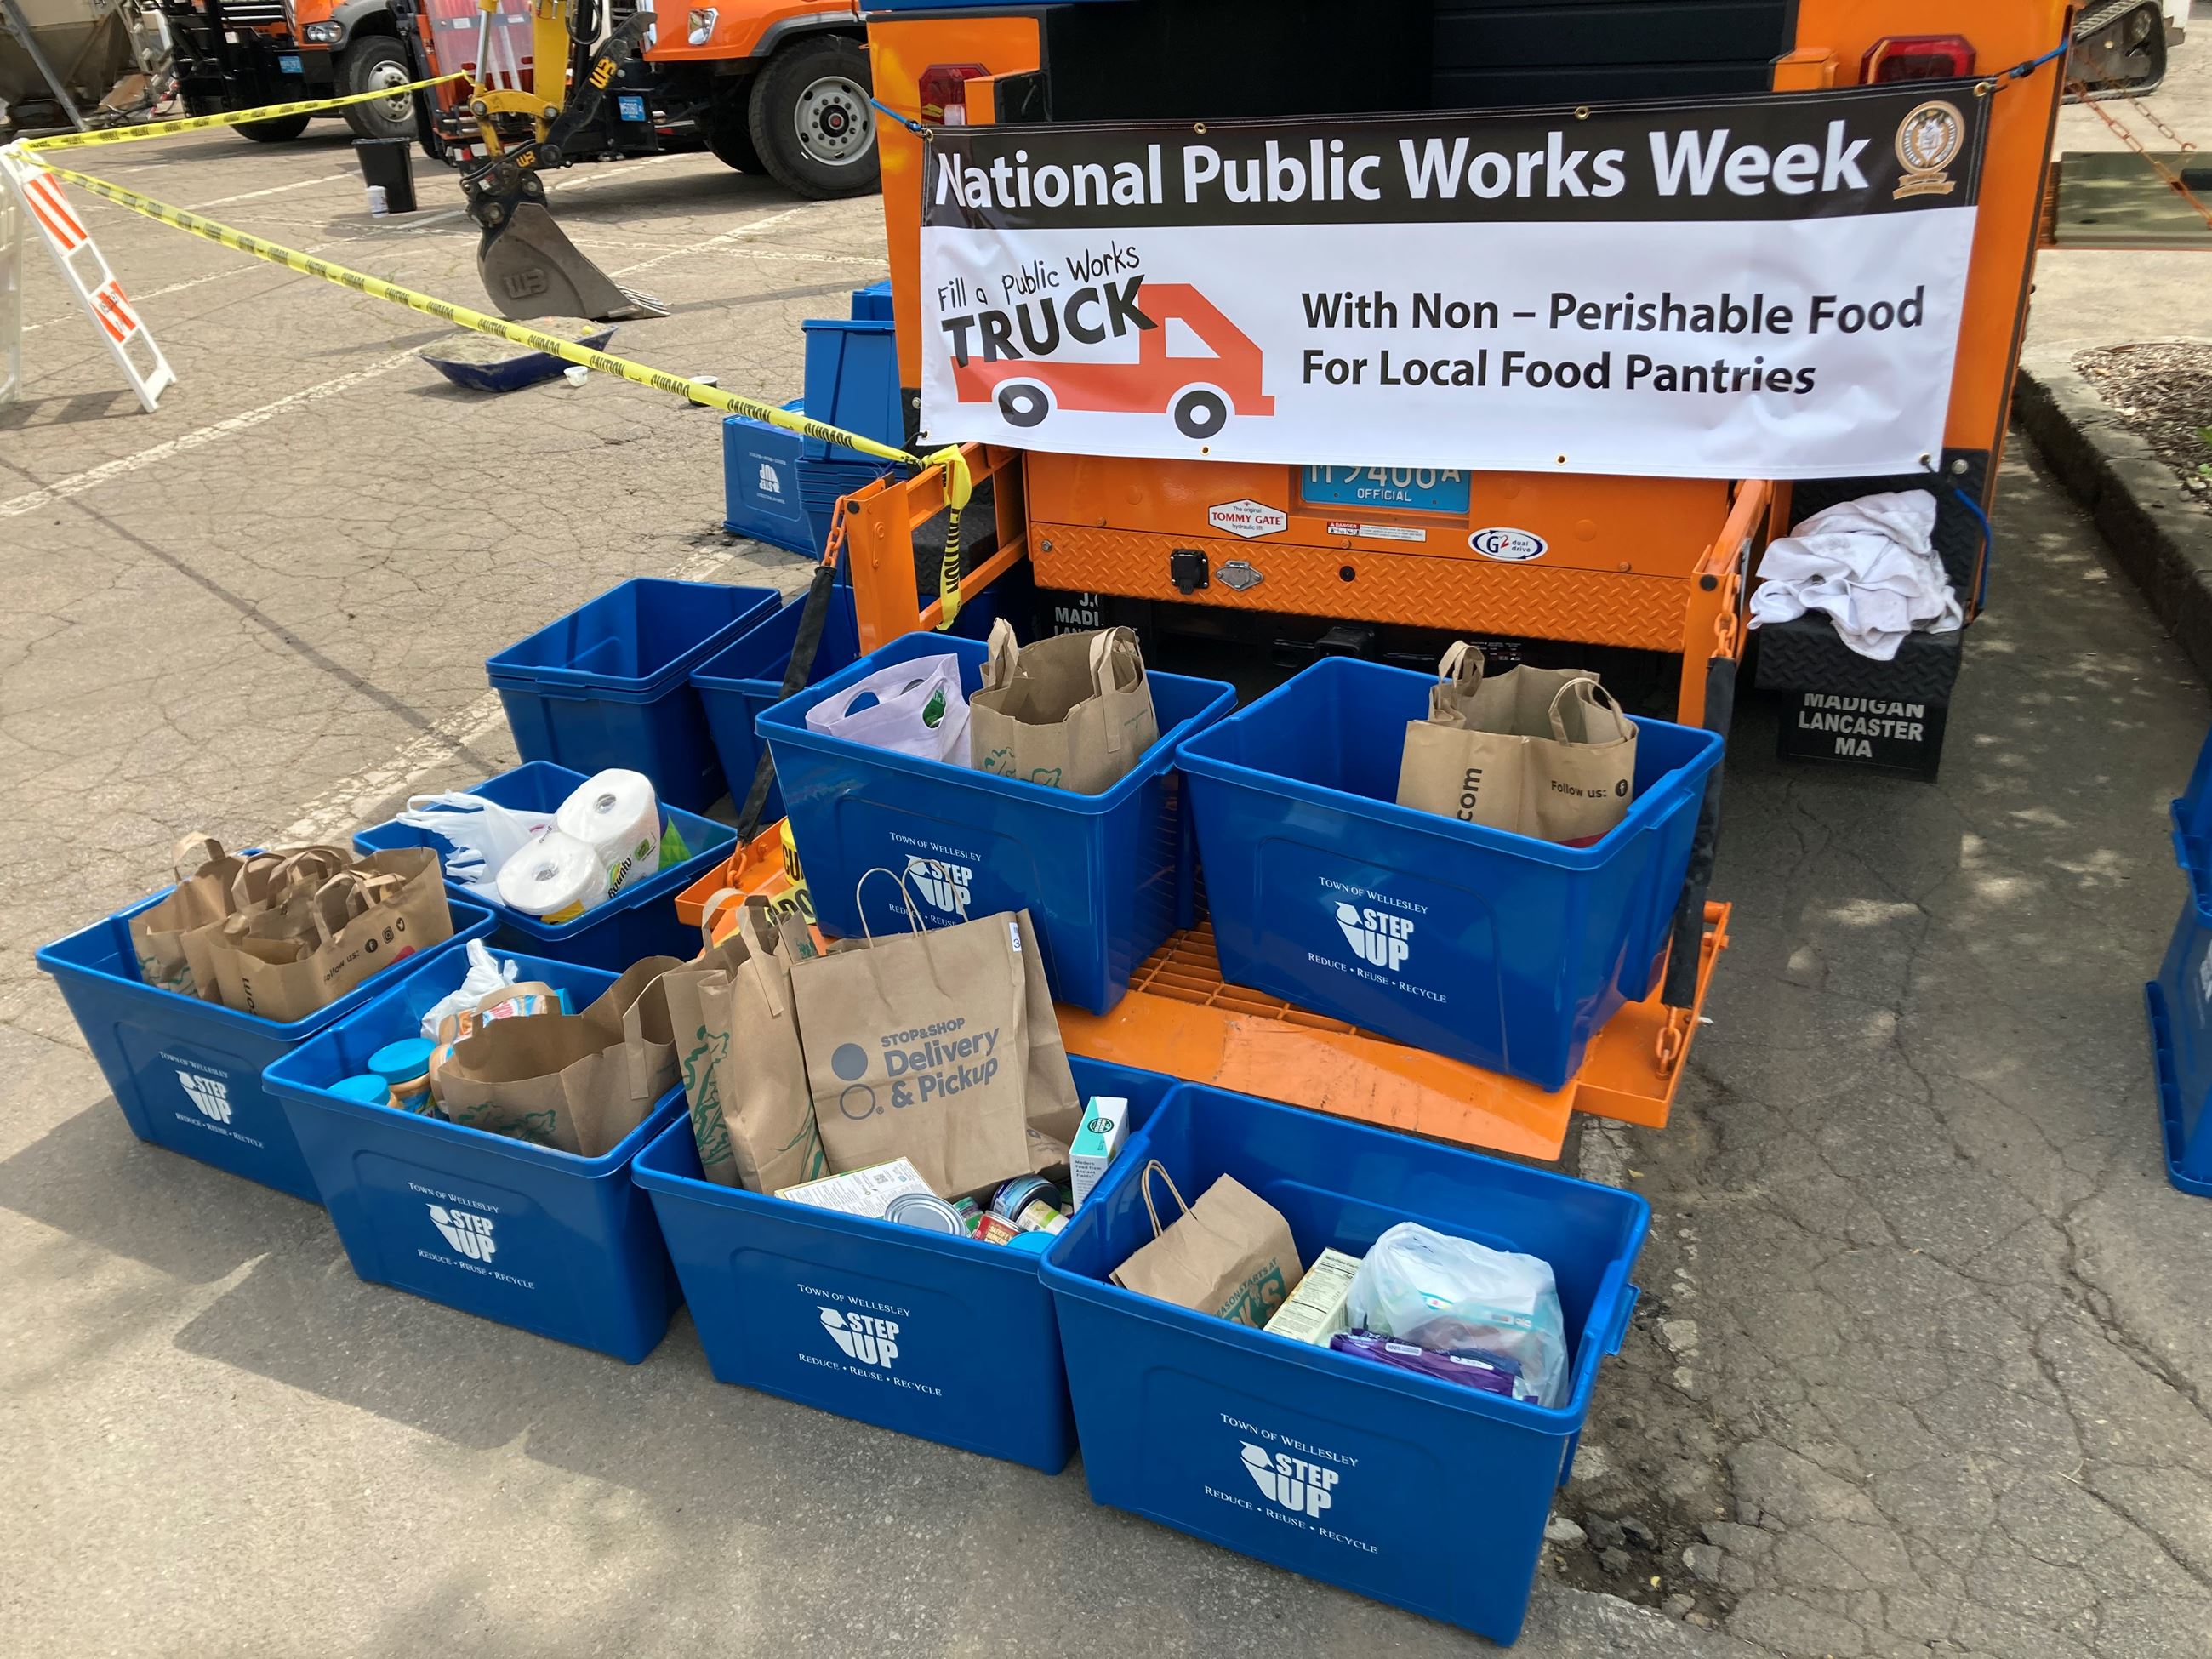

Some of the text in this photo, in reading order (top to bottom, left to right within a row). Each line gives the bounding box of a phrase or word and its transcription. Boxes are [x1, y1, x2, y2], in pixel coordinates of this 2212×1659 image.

[936, 143, 1163, 208] National
[1183, 139, 1381, 204] Public
[1399, 130, 1625, 199] Works
[1649, 119, 1872, 197] Week
[938, 240, 1140, 311] Fill a Public Works
[941, 274, 1159, 368] TRUCK
[1302, 290, 1398, 328] With
[1412, 292, 1498, 328] Non
[1549, 291, 1792, 334] Perishable
[1808, 285, 1924, 334] Food
[477, 317, 507, 339] CAUTION
[527, 334, 560, 356] CUIDADO
[589, 354, 625, 377] CAUTION
[650, 373, 690, 399] CUIDADO
[727, 398, 772, 424] CAUTION
[803, 422, 856, 450] CUIDADO
[1303, 349, 1816, 395] For Local Food Pantries
[1357, 487, 1412, 502] OFFICIAL
[1212, 512, 1281, 525] TOMMY GATE
[1804, 693, 1924, 718] MADIGAN
[1798, 711, 1924, 742] LANCASTER
[1835, 737, 1873, 758] MA
[1551, 780, 1583, 797] Follow
[1587, 789, 1607, 798] us:
[889, 832, 982, 862] TOWN OF WELLESLEY
[607, 856, 632, 899] Bounty
[929, 859, 972, 887] STEP
[933, 879, 971, 915] UP
[1319, 876, 1428, 915] TOWN OF WELLESLEY
[1363, 908, 1414, 940] STEP
[1013, 938, 1021, 949] 3
[1365, 930, 1409, 972] UP
[1308, 952, 1447, 1003] REDUCE REUSE RECYCLE
[881, 1018, 965, 1047] STOP&SHOP
[158, 1051, 180, 1063] TOWN
[189, 1061, 228, 1078] WELLESLEY
[884, 1028, 1000, 1077] Delivery
[193, 1075, 228, 1100] STEP
[891, 1057, 998, 1108] & Pickup
[200, 1093, 232, 1125] UP
[175, 1112, 202, 1126] REDUCE
[232, 1132, 265, 1149] RECYCLE
[408, 1182, 499, 1214] TOWN OF WELLESLEY
[450, 1209, 493, 1236] STEP
[455, 1228, 496, 1263] UP
[417, 1248, 535, 1290] REDUCE REUSE RECYCLE
[797, 1284, 910, 1317] TOWN OF WELLESLEY
[1214, 1291, 1241, 1318] EASON
[1239, 1265, 1268, 1293] STARTS
[847, 1312, 899, 1341] STEP
[852, 1331, 898, 1369] UP
[798, 1353, 942, 1397] REDUCE REUSE RECYCLE
[1220, 1413, 1359, 1467] TOWN OF WELLESLEY
[1275, 1452, 1339, 1491] STEP
[1277, 1474, 1331, 1519] UP
[1204, 1485, 1378, 1554] REDUCE REUSE RECYCLE
